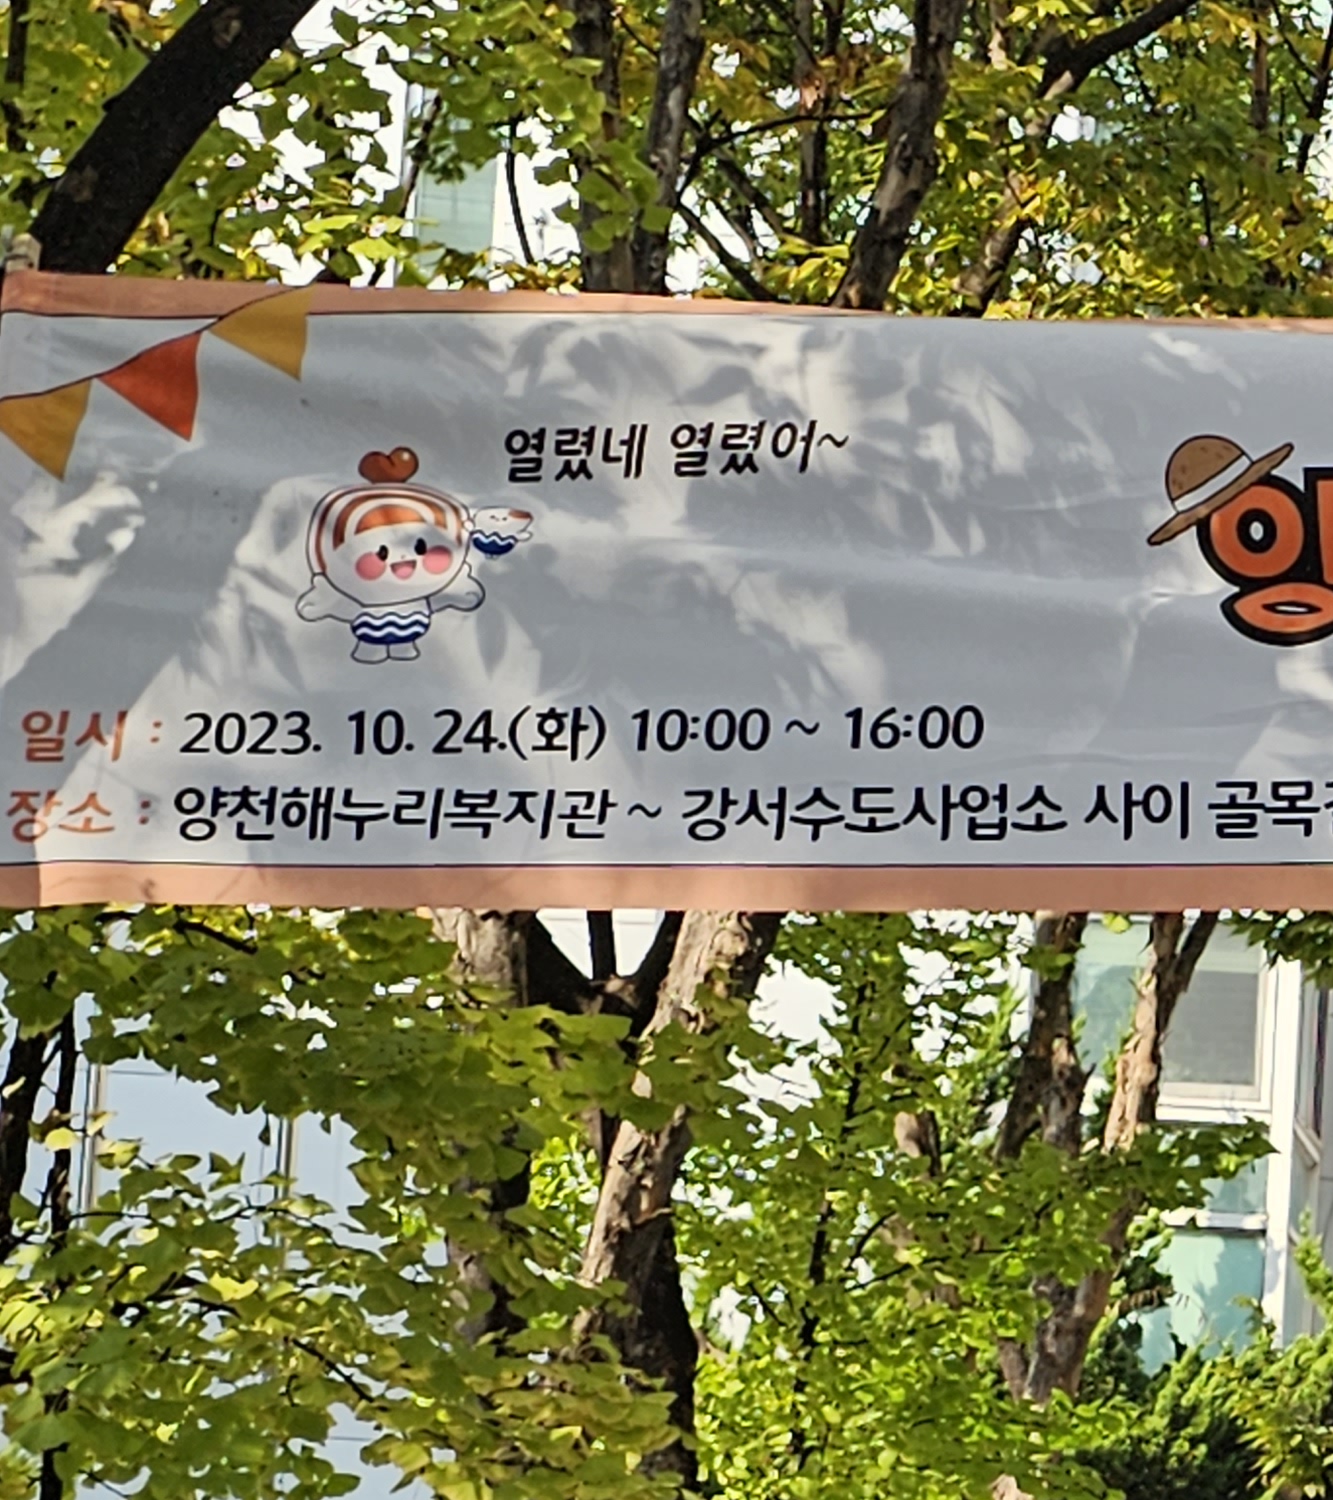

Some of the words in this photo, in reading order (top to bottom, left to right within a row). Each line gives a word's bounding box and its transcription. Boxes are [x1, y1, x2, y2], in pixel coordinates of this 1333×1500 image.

[503, 424, 646, 483] 열렸네
[669, 419, 849, 478] 열렸어~
[21, 709, 129, 763] 일시
[179, 711, 322, 755] 2023.
[348, 708, 415, 755] 10.
[431, 704, 607, 762] 24.(화)
[631, 707, 770, 752] 10:00
[844, 705, 984, 750] 16:00
[6, 788, 116, 843] 장소
[173, 785, 619, 842] 양천해누리복지관
[681, 783, 1069, 842] 강서수도사업소
[1083, 780, 1191, 841] 사이
